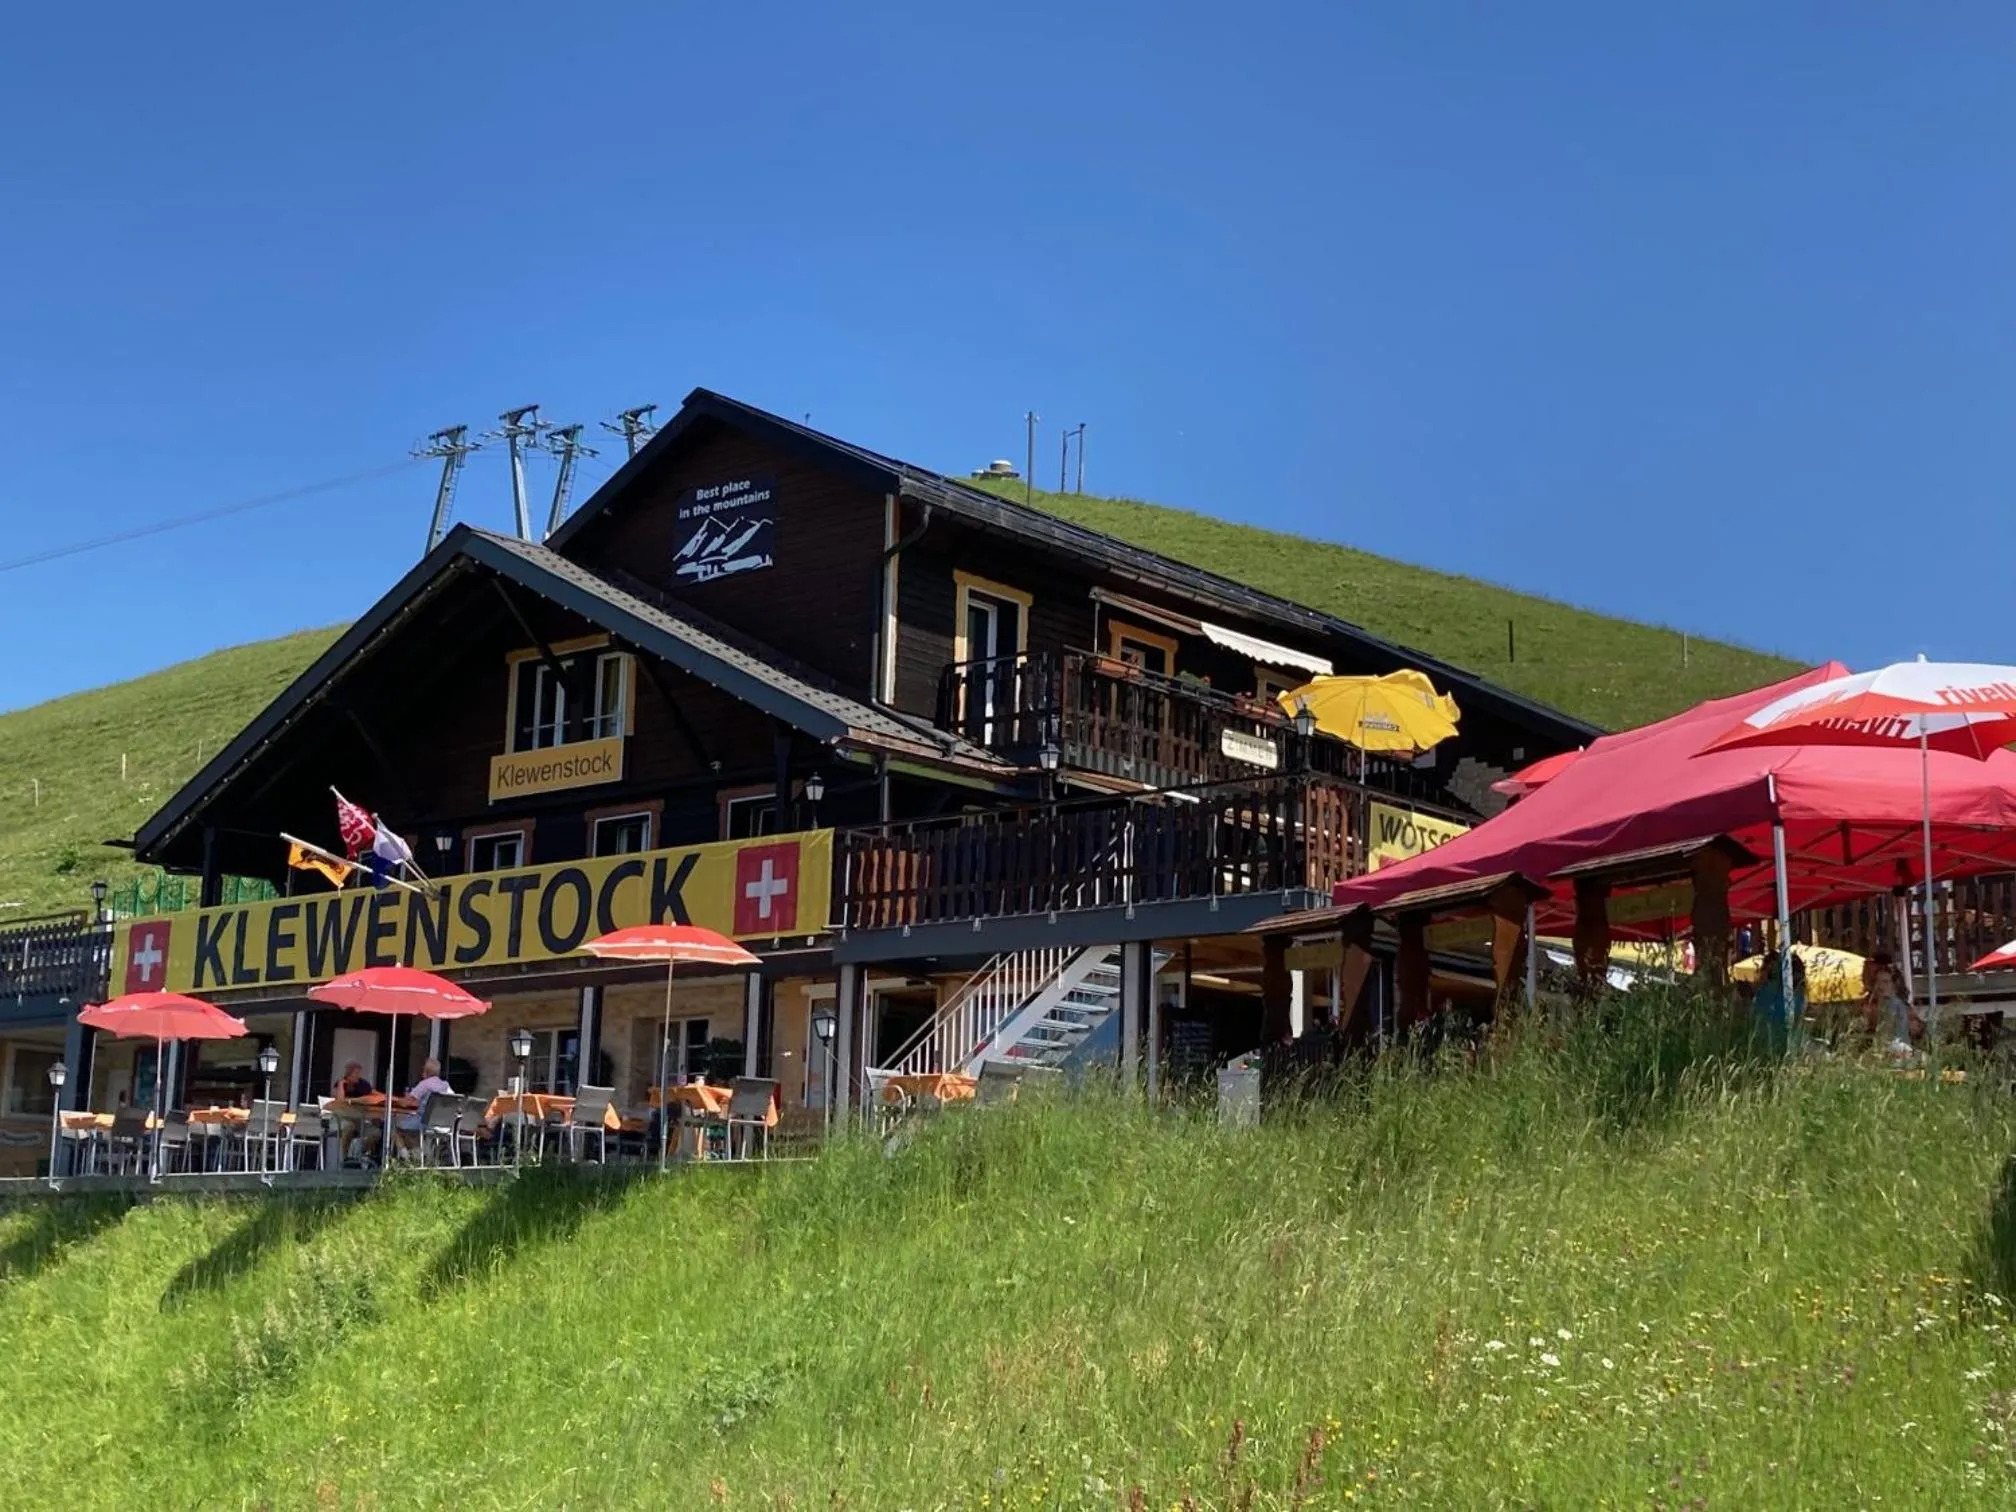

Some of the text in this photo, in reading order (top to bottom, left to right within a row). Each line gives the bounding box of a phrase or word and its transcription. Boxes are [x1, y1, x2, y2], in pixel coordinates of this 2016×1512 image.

[679, 490, 770, 519] in the mountains
[696, 480, 751, 501] Best place
[1935, 682, 2016, 704] rivell
[497, 749, 612, 789] Klewenstock
[193, 853, 702, 988] KLEWENSTOCK
